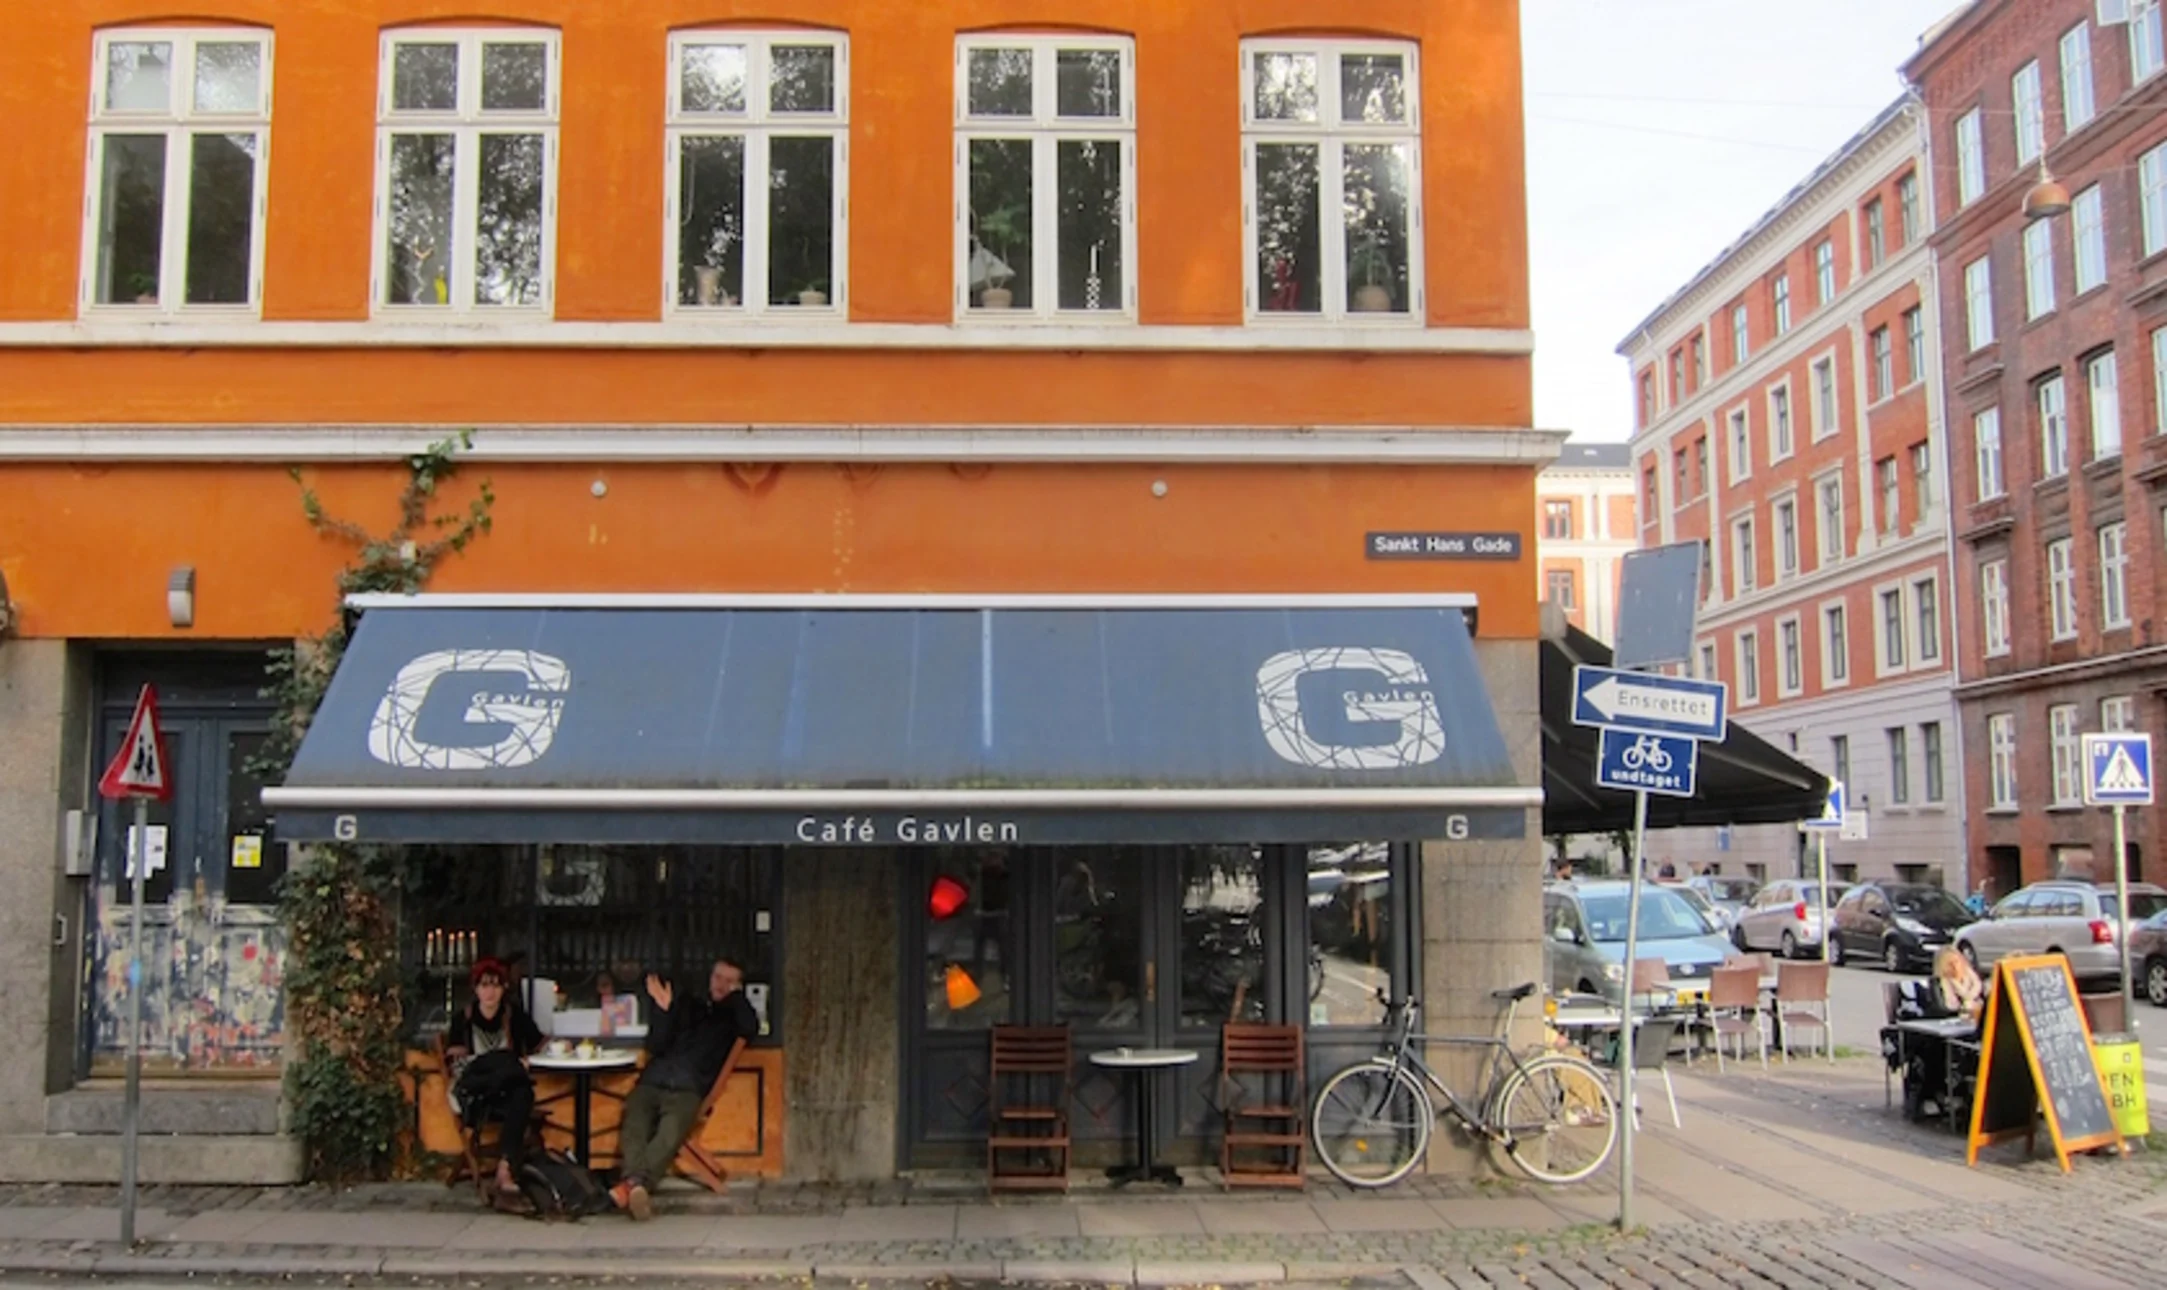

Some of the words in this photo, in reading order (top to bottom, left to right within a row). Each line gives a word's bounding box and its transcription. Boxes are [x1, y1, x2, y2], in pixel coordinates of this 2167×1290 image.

[1374, 536, 1419, 552] Sankt
[1426, 536, 1465, 552] Hans
[1472, 536, 1512, 552] Gade
[368, 649, 571, 770] G
[471, 690, 565, 709] Gavlen
[1256, 647, 1446, 769] G
[1343, 689, 1436, 707] Gavlen
[1617, 690, 1708, 716] Ensrettet
[1611, 770, 1682, 788] undtaget
[334, 814, 357, 841] G
[796, 816, 876, 843] Café
[896, 816, 1018, 843] Gavlen
[1446, 814, 1469, 840] G
